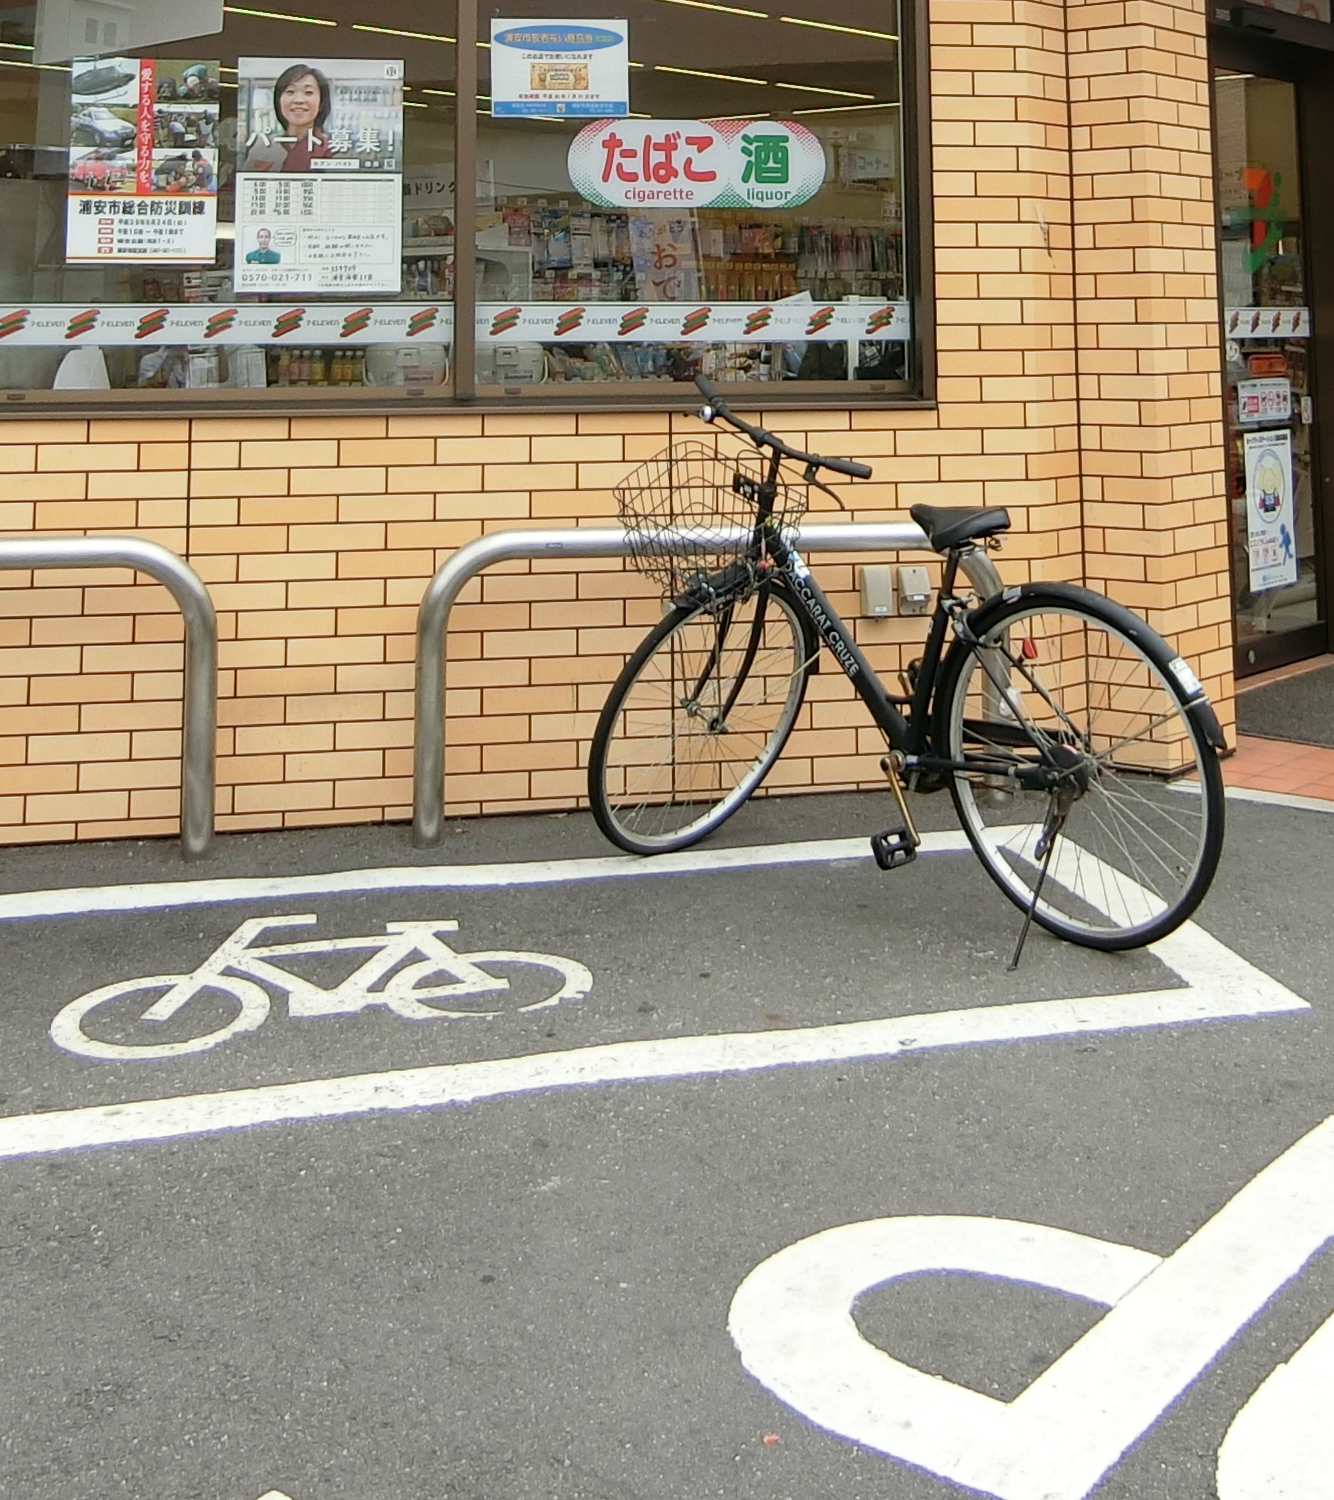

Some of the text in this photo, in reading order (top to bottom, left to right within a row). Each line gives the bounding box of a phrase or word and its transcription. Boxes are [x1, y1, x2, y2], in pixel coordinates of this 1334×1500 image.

[601, 131, 790, 185] たばこ 酒
[624, 186, 792, 203] cigarette liquor
[78, 199, 206, 216] 浦安市総合防災訓練
[241, 273, 313, 282] 0570-021-711
[828, 630, 860, 677] CRUZE
